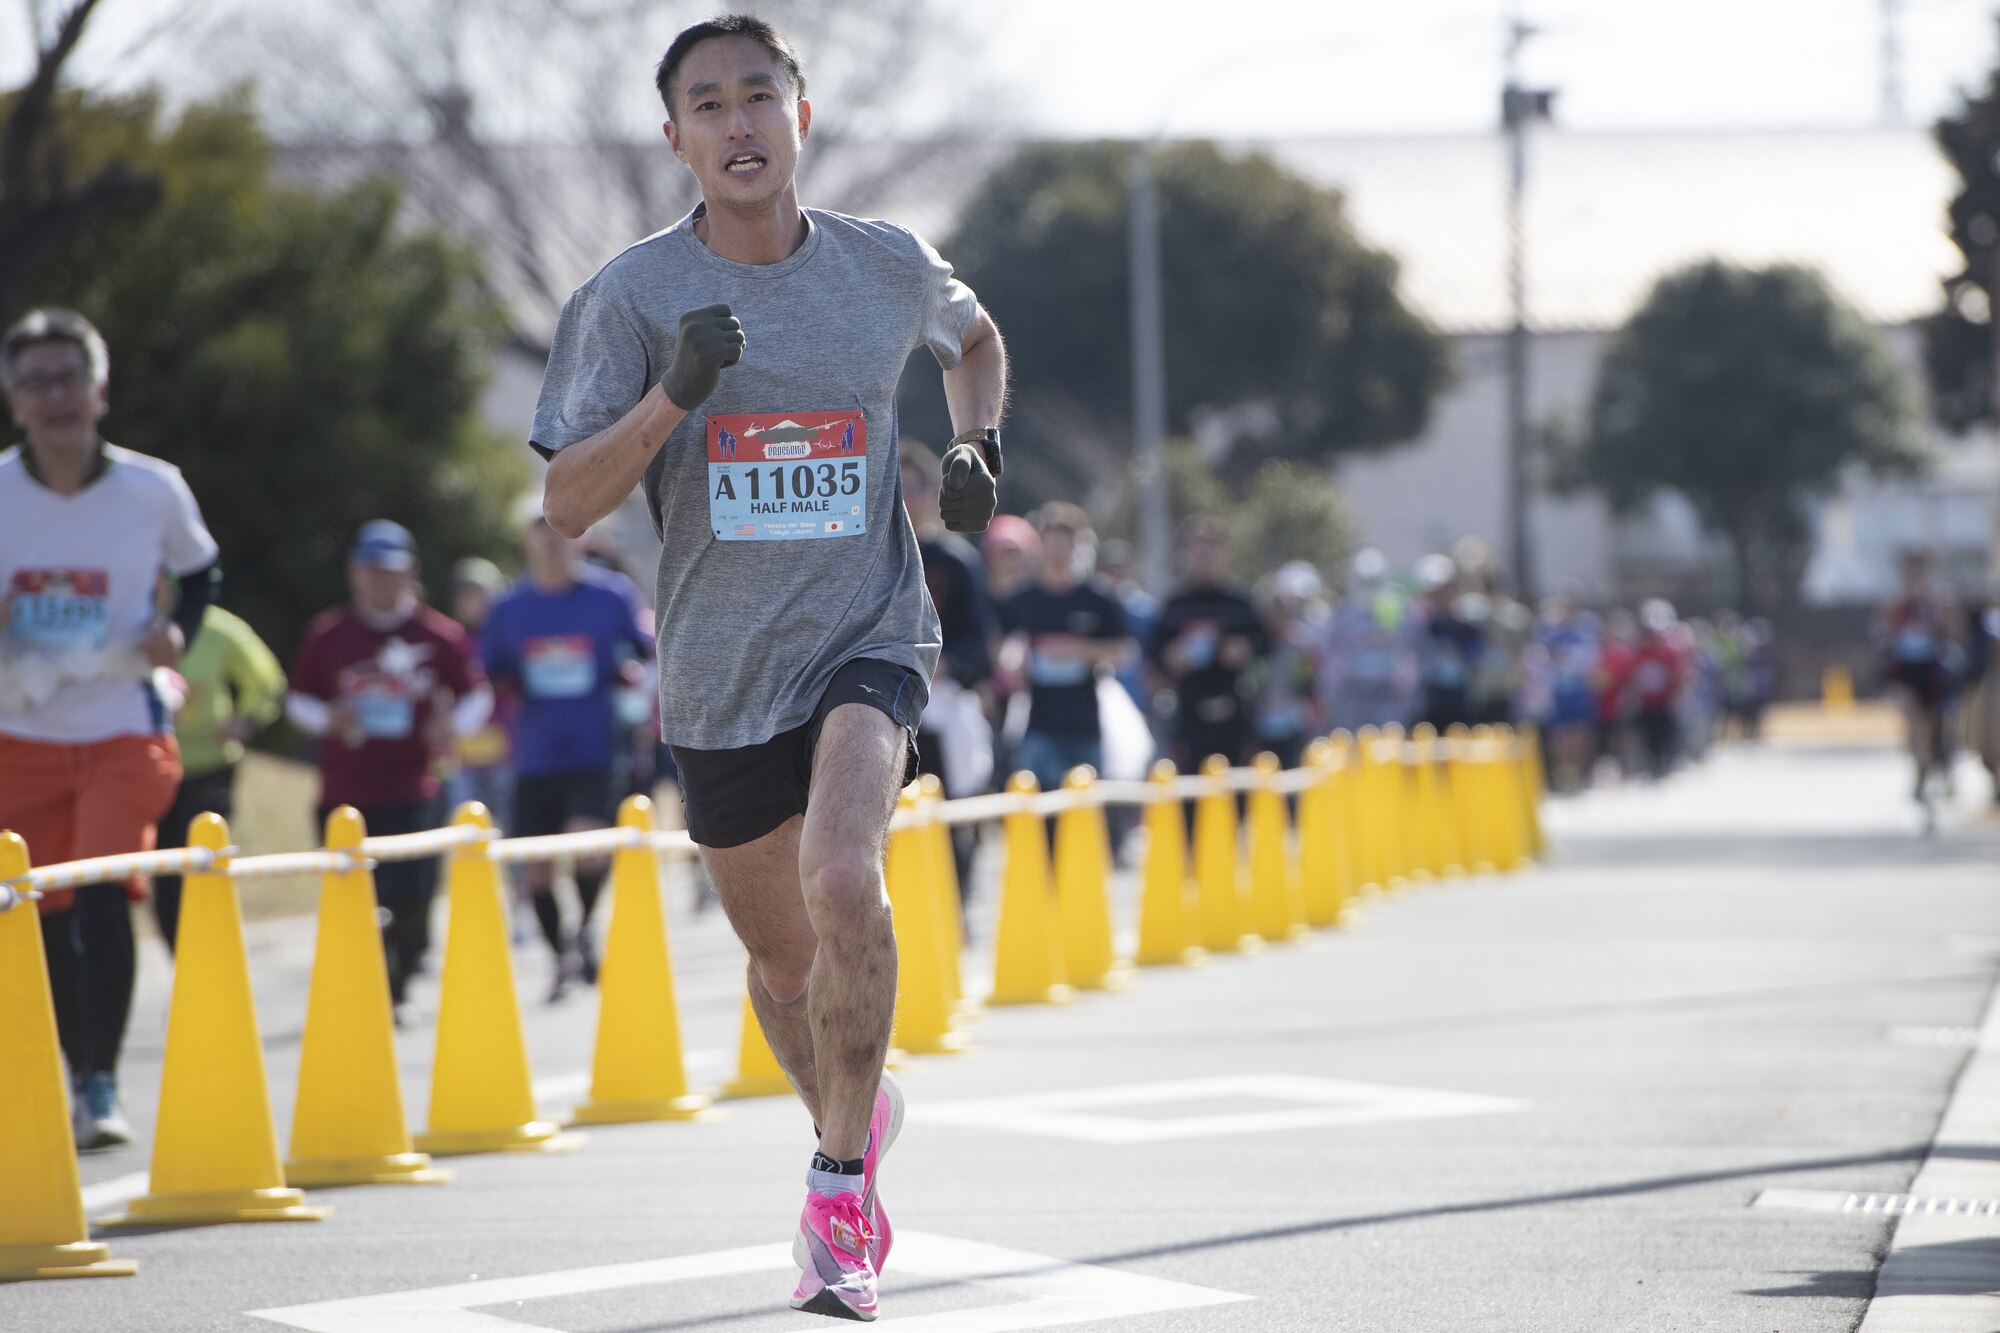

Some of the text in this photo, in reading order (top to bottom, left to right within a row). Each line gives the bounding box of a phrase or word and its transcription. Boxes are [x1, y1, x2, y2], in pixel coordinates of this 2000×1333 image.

[715, 462, 861, 500] A 11035
[750, 500, 830, 515] HALF MALE
